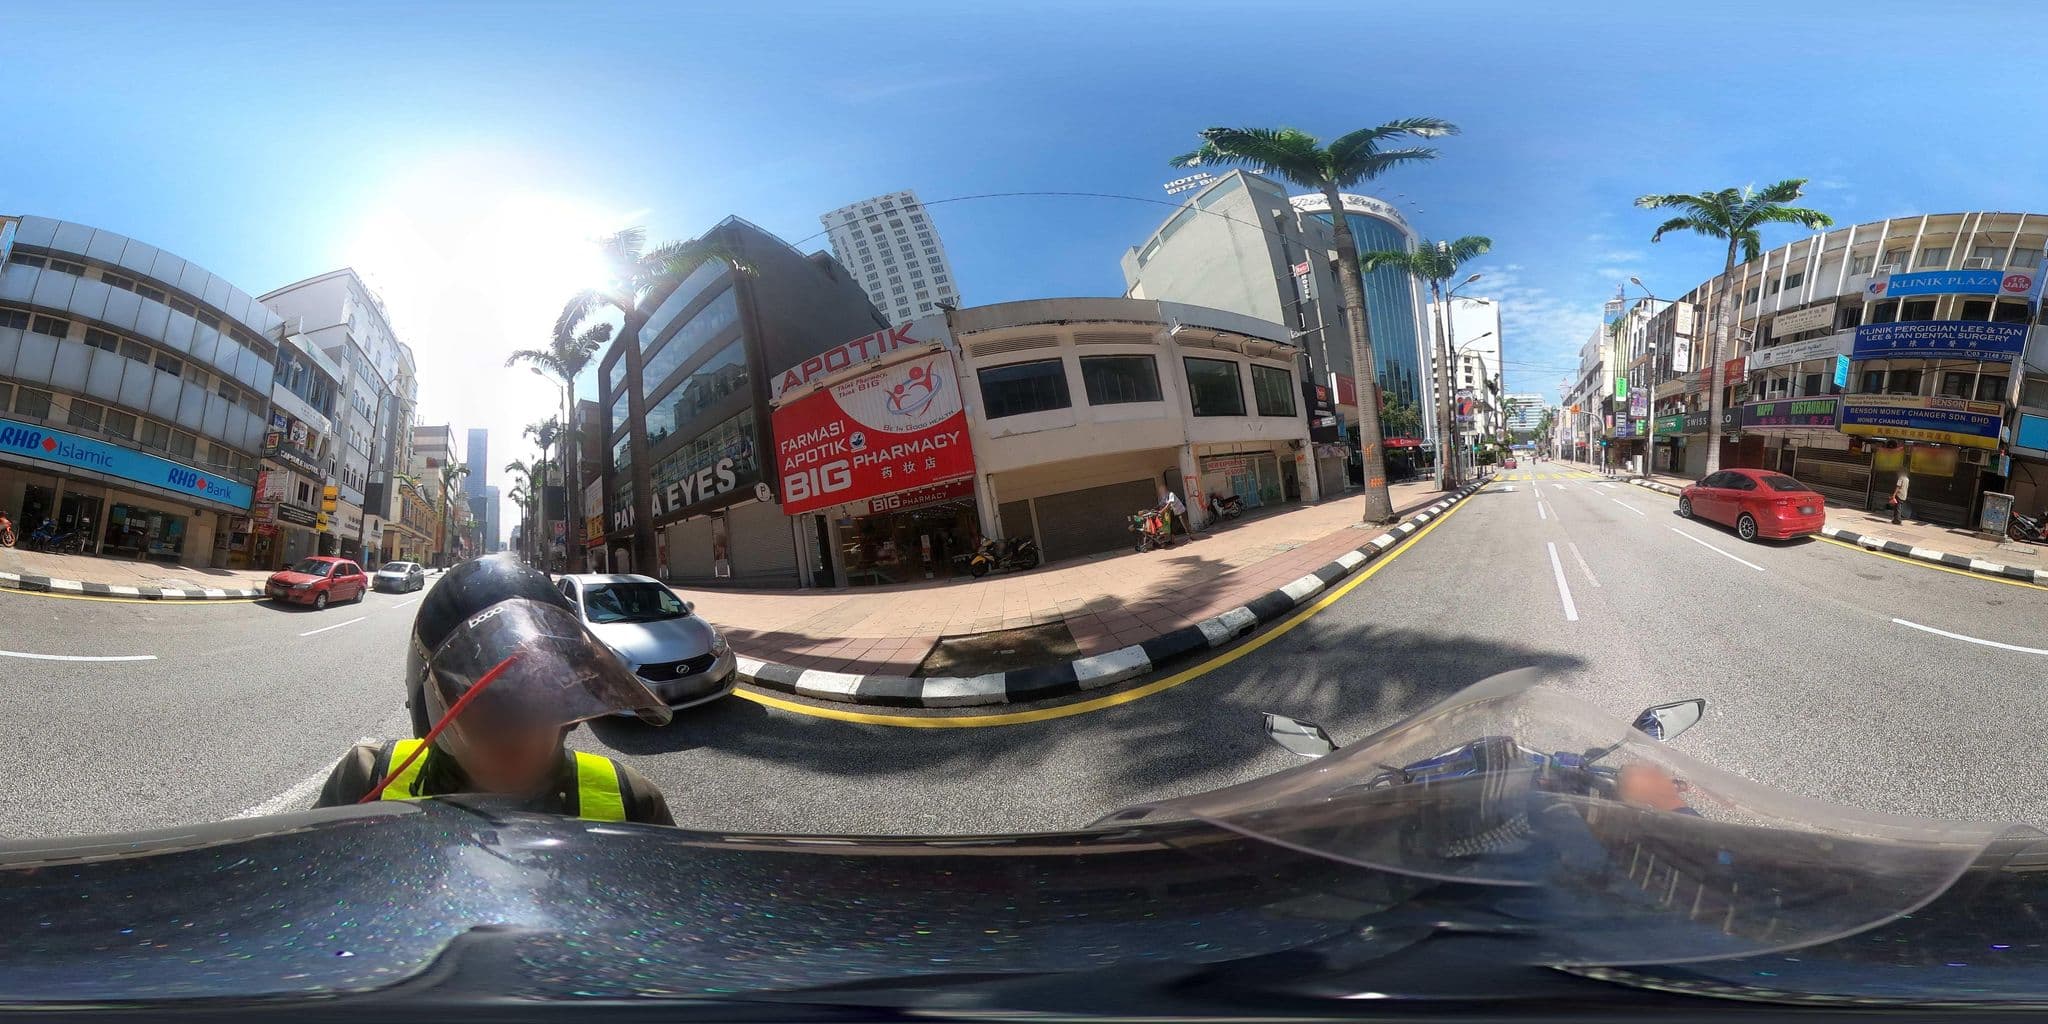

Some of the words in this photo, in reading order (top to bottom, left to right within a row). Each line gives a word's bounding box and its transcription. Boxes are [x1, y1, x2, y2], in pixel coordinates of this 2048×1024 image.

[1163, 172, 1212, 189] HOTEL
[1167, 184, 1197, 195] BITZ
[1891, 278, 1941, 289] KLINIK
[1948, 277, 1998, 286] PLAZA
[2004, 281, 2029, 289] JAM
[1860, 327, 1893, 335] KLINIK
[1895, 325, 1957, 334] PERGIGIAN
[1960, 325, 1984, 333] LEE
[1999, 327, 2023, 336] TAN
[1957, 333, 2010, 343] SURGERY
[782, 323, 920, 394] APOTIK
[858, 380, 879, 391] BIG
[1756, 403, 1775, 416] HAPPY
[1791, 400, 1836, 415] RESTAURANT
[1932, 399, 1965, 409] BENSON
[1879, 408, 1906, 416] MONEY
[1907, 410, 1947, 419] CHANGER
[1686, 417, 1707, 427] SWISS
[1879, 418, 1909, 426] CHANGER
[781, 420, 845, 455] FARMASI
[0, 427, 41, 449] RHB
[57, 441, 113, 468] Islamic
[784, 439, 848, 471] APOTIK
[784, 460, 852, 503] BIG
[853, 430, 960, 469] PHARMACY
[881, 457, 936, 479] 药妆店
[168, 468, 197, 488] RHB
[207, 481, 232, 500] Bank
[667, 457, 736, 513] EYES
[872, 496, 900, 512] BIG
[902, 491, 948, 507] PHARMACY
